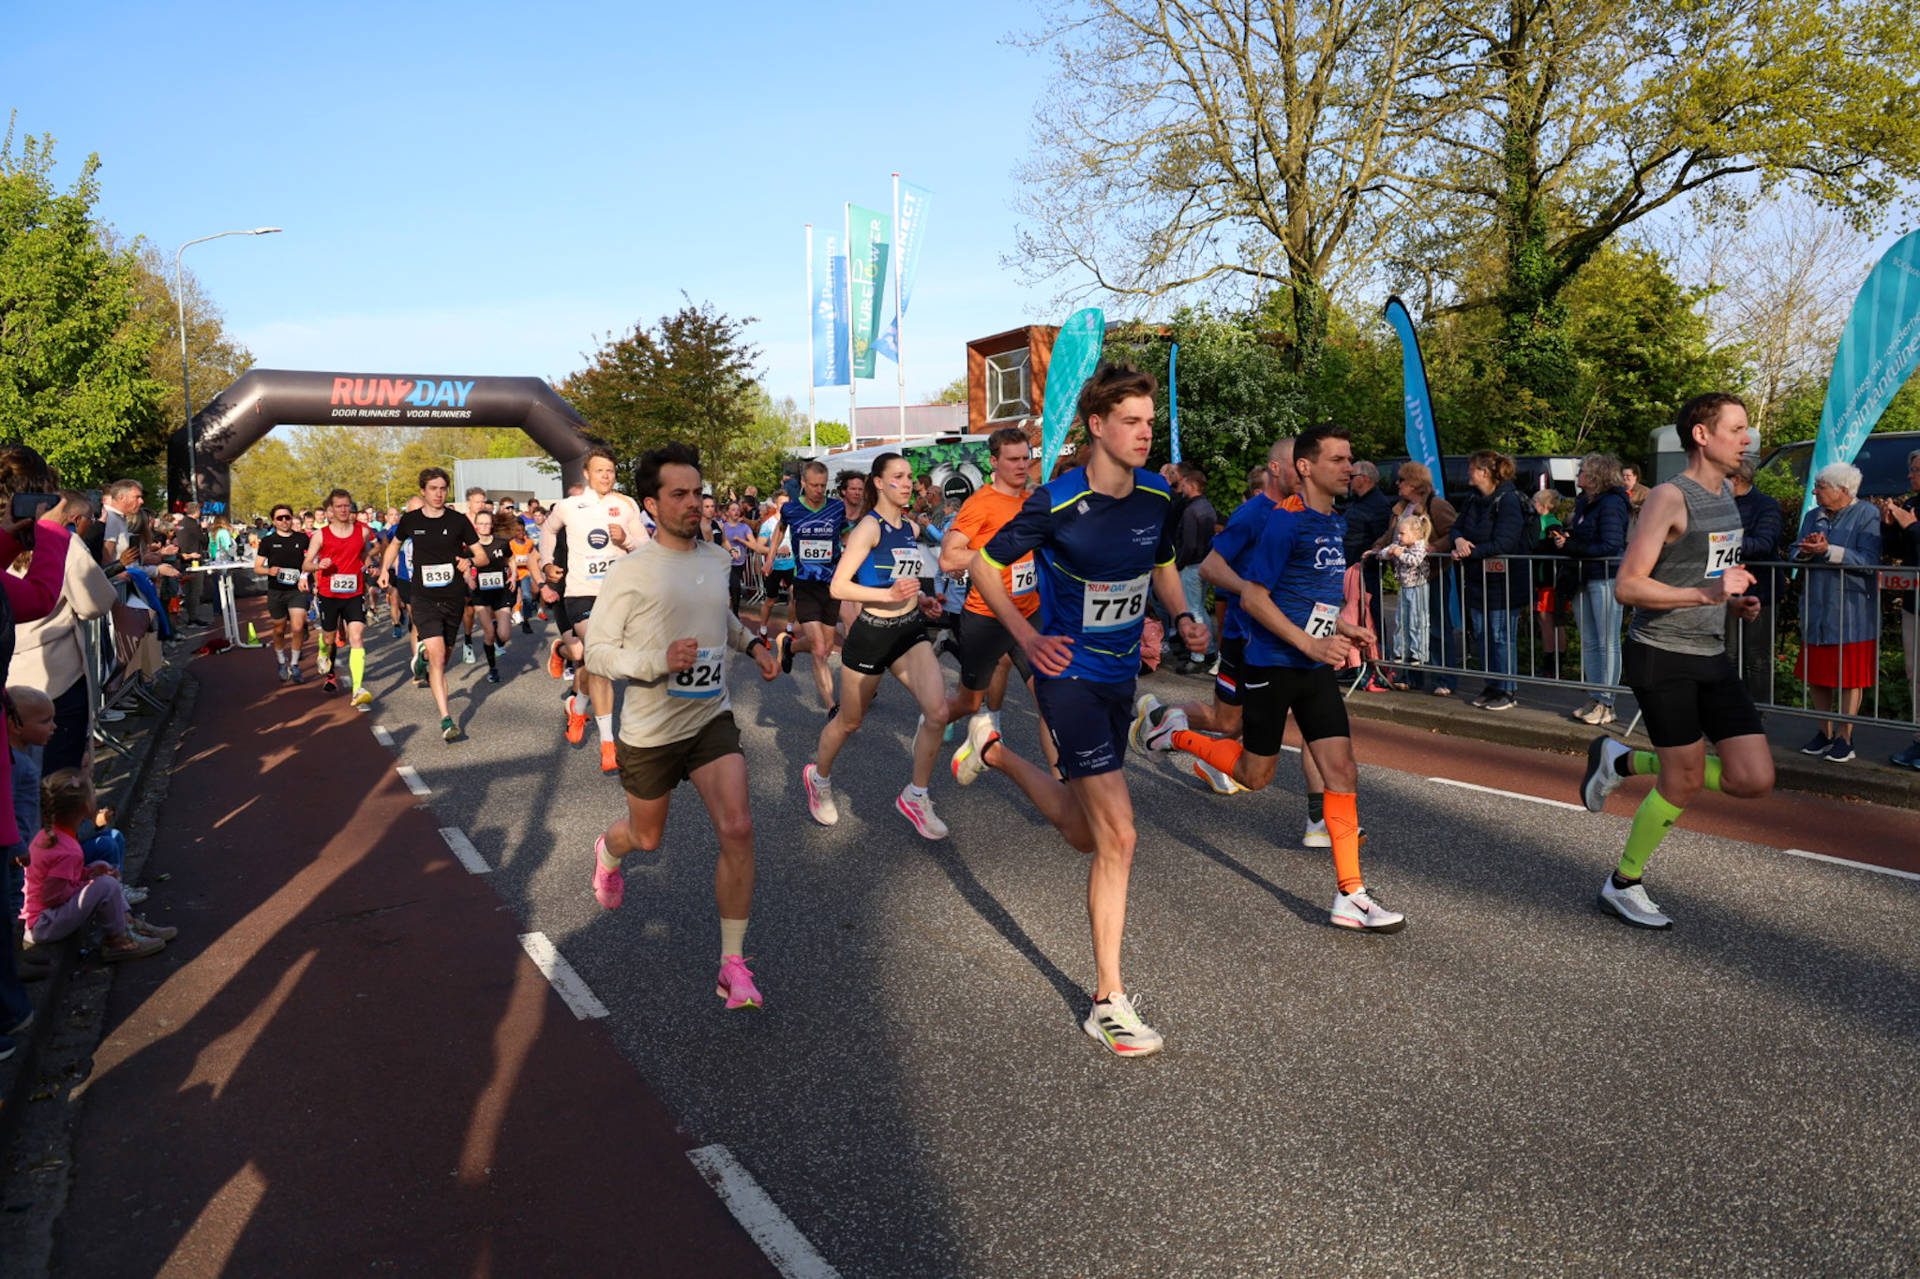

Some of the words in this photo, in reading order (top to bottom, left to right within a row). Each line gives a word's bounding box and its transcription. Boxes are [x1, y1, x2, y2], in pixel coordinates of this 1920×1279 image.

[331, 408, 357, 417] DOOR
[358, 409, 401, 418] RUNNERS
[406, 410, 429, 418] VOOR
[431, 410, 472, 418] RUNNERS
[804, 549, 828, 558] 687
[1715, 546, 1742, 568] 746
[898, 559, 922, 576] 779
[425, 571, 452, 582] 838
[481, 577, 501, 587] 810
[333, 580, 355, 589] 822
[1092, 593, 1143, 622] 778
[676, 662, 722, 687] 824
